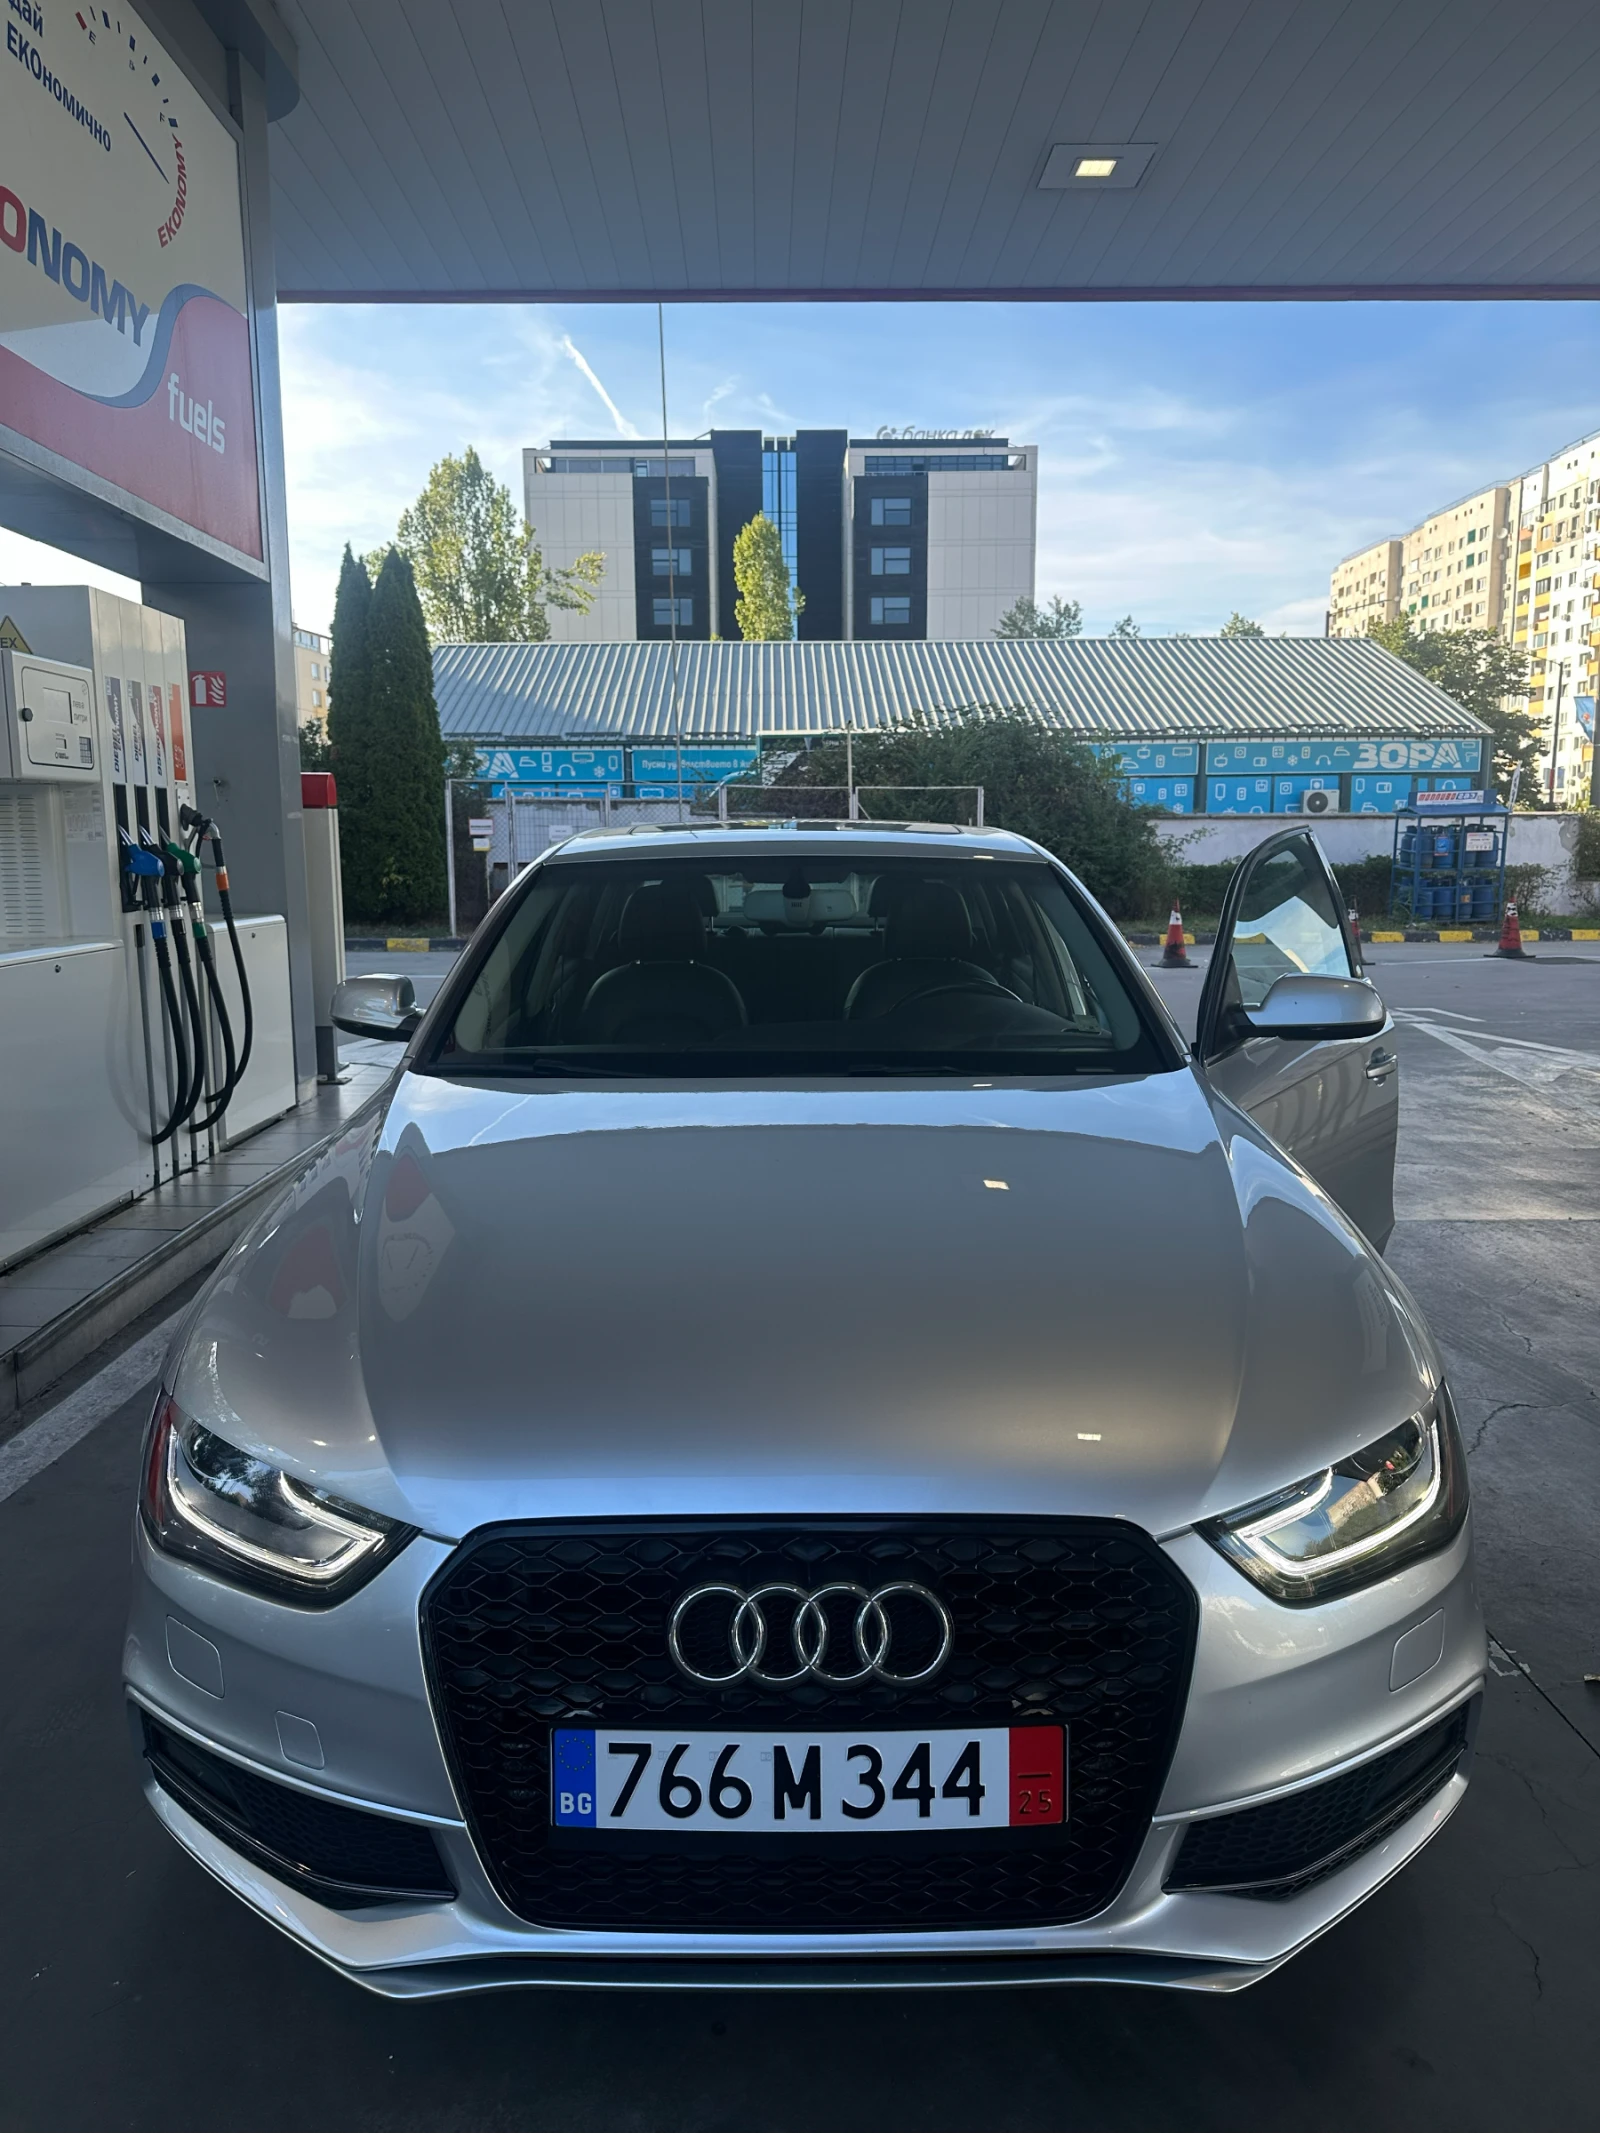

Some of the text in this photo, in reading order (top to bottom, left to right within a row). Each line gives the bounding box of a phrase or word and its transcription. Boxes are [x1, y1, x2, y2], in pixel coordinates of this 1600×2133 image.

[7, 20, 111, 152] ЕКОномично
[157, 133, 188, 248] EKONOMY
[167, 372, 225, 454] fuels
[1352, 742, 1462, 769] ЗОРА
[560, 1741, 1052, 1820] BG 766 M 344 25
